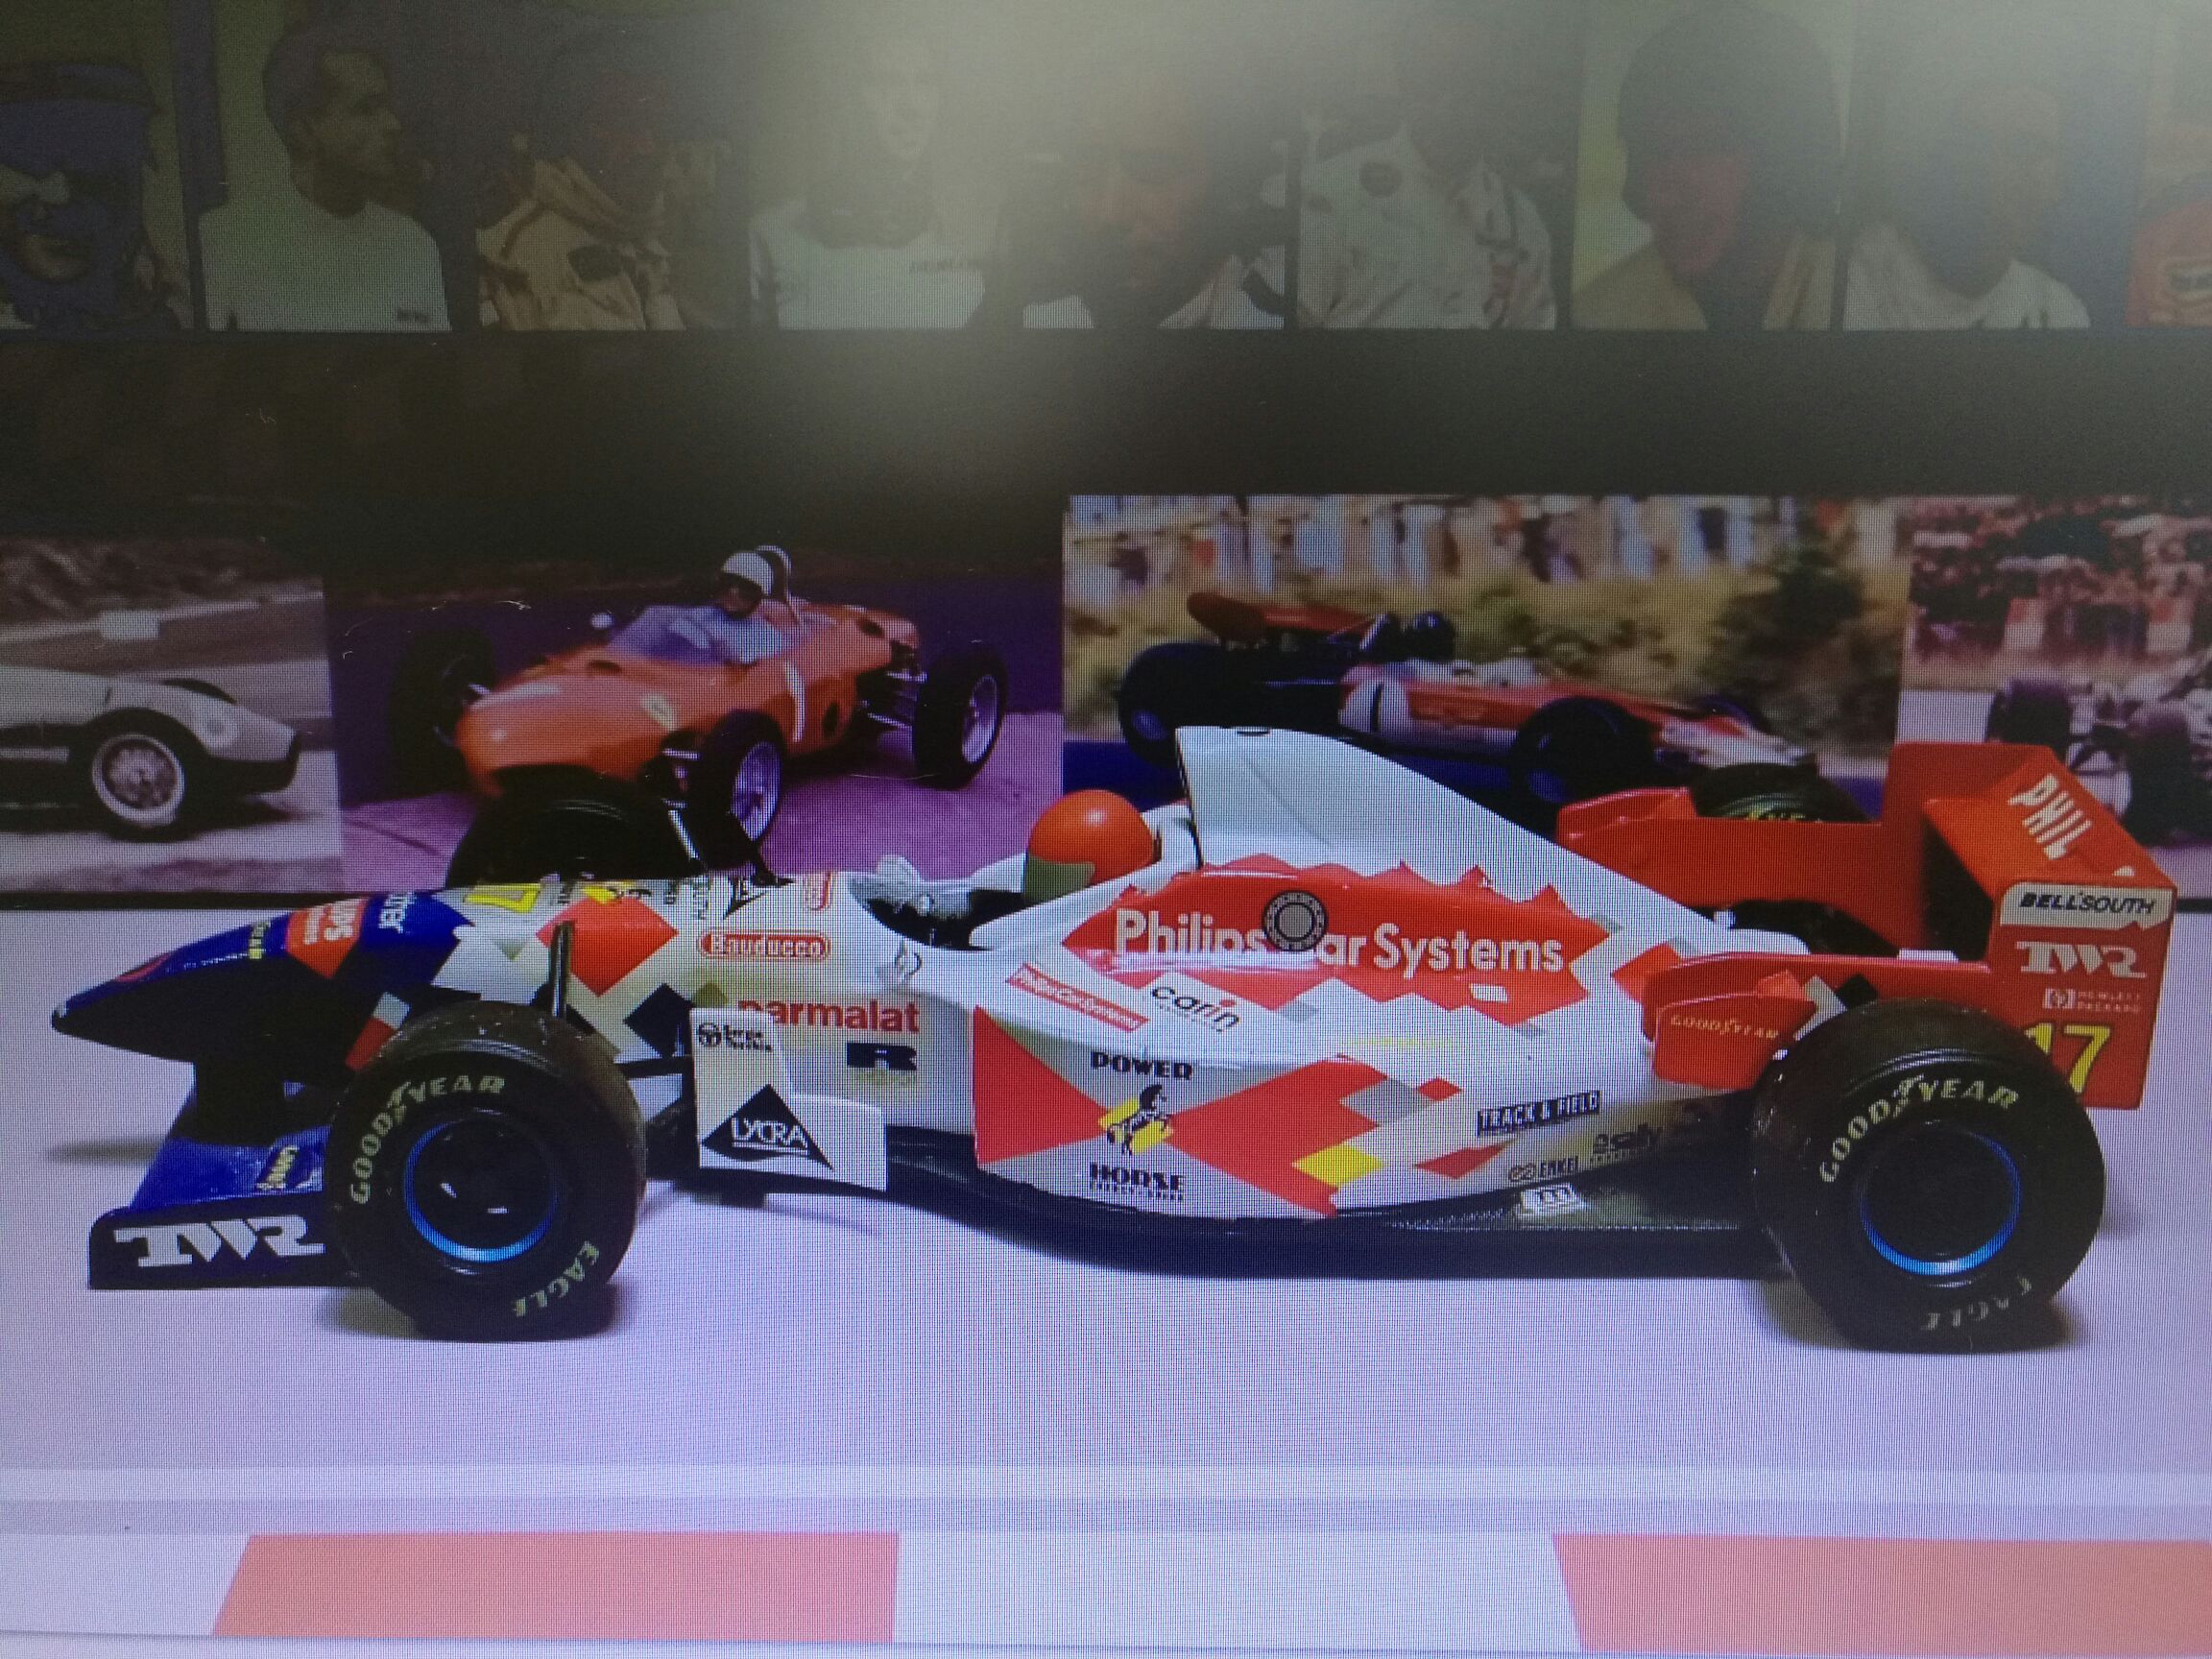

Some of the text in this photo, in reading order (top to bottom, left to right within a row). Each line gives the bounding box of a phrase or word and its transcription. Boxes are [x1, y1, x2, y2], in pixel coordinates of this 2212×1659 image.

[2008, 773, 2092, 860] PHIL
[709, 933, 823, 957] Bauducco
[1117, 908, 1267, 961] Philips
[1374, 923, 1564, 979] Systems
[2015, 941, 2148, 978] TWR
[1151, 986, 1241, 1031] carin
[1091, 1051, 1193, 1080] POWER
[731, 1117, 808, 1149] LYCRA
[1479, 1103, 1536, 1131] TRACK
[1556, 1093, 1599, 1116] FIELD
[1819, 1072, 2019, 1183] GOODYEAR
[349, 1074, 505, 1204] GOODYEAR
[1090, 1163, 1187, 1191] HORSE
[113, 1214, 326, 1267] TWR
[512, 1240, 599, 1317] EAGLE
